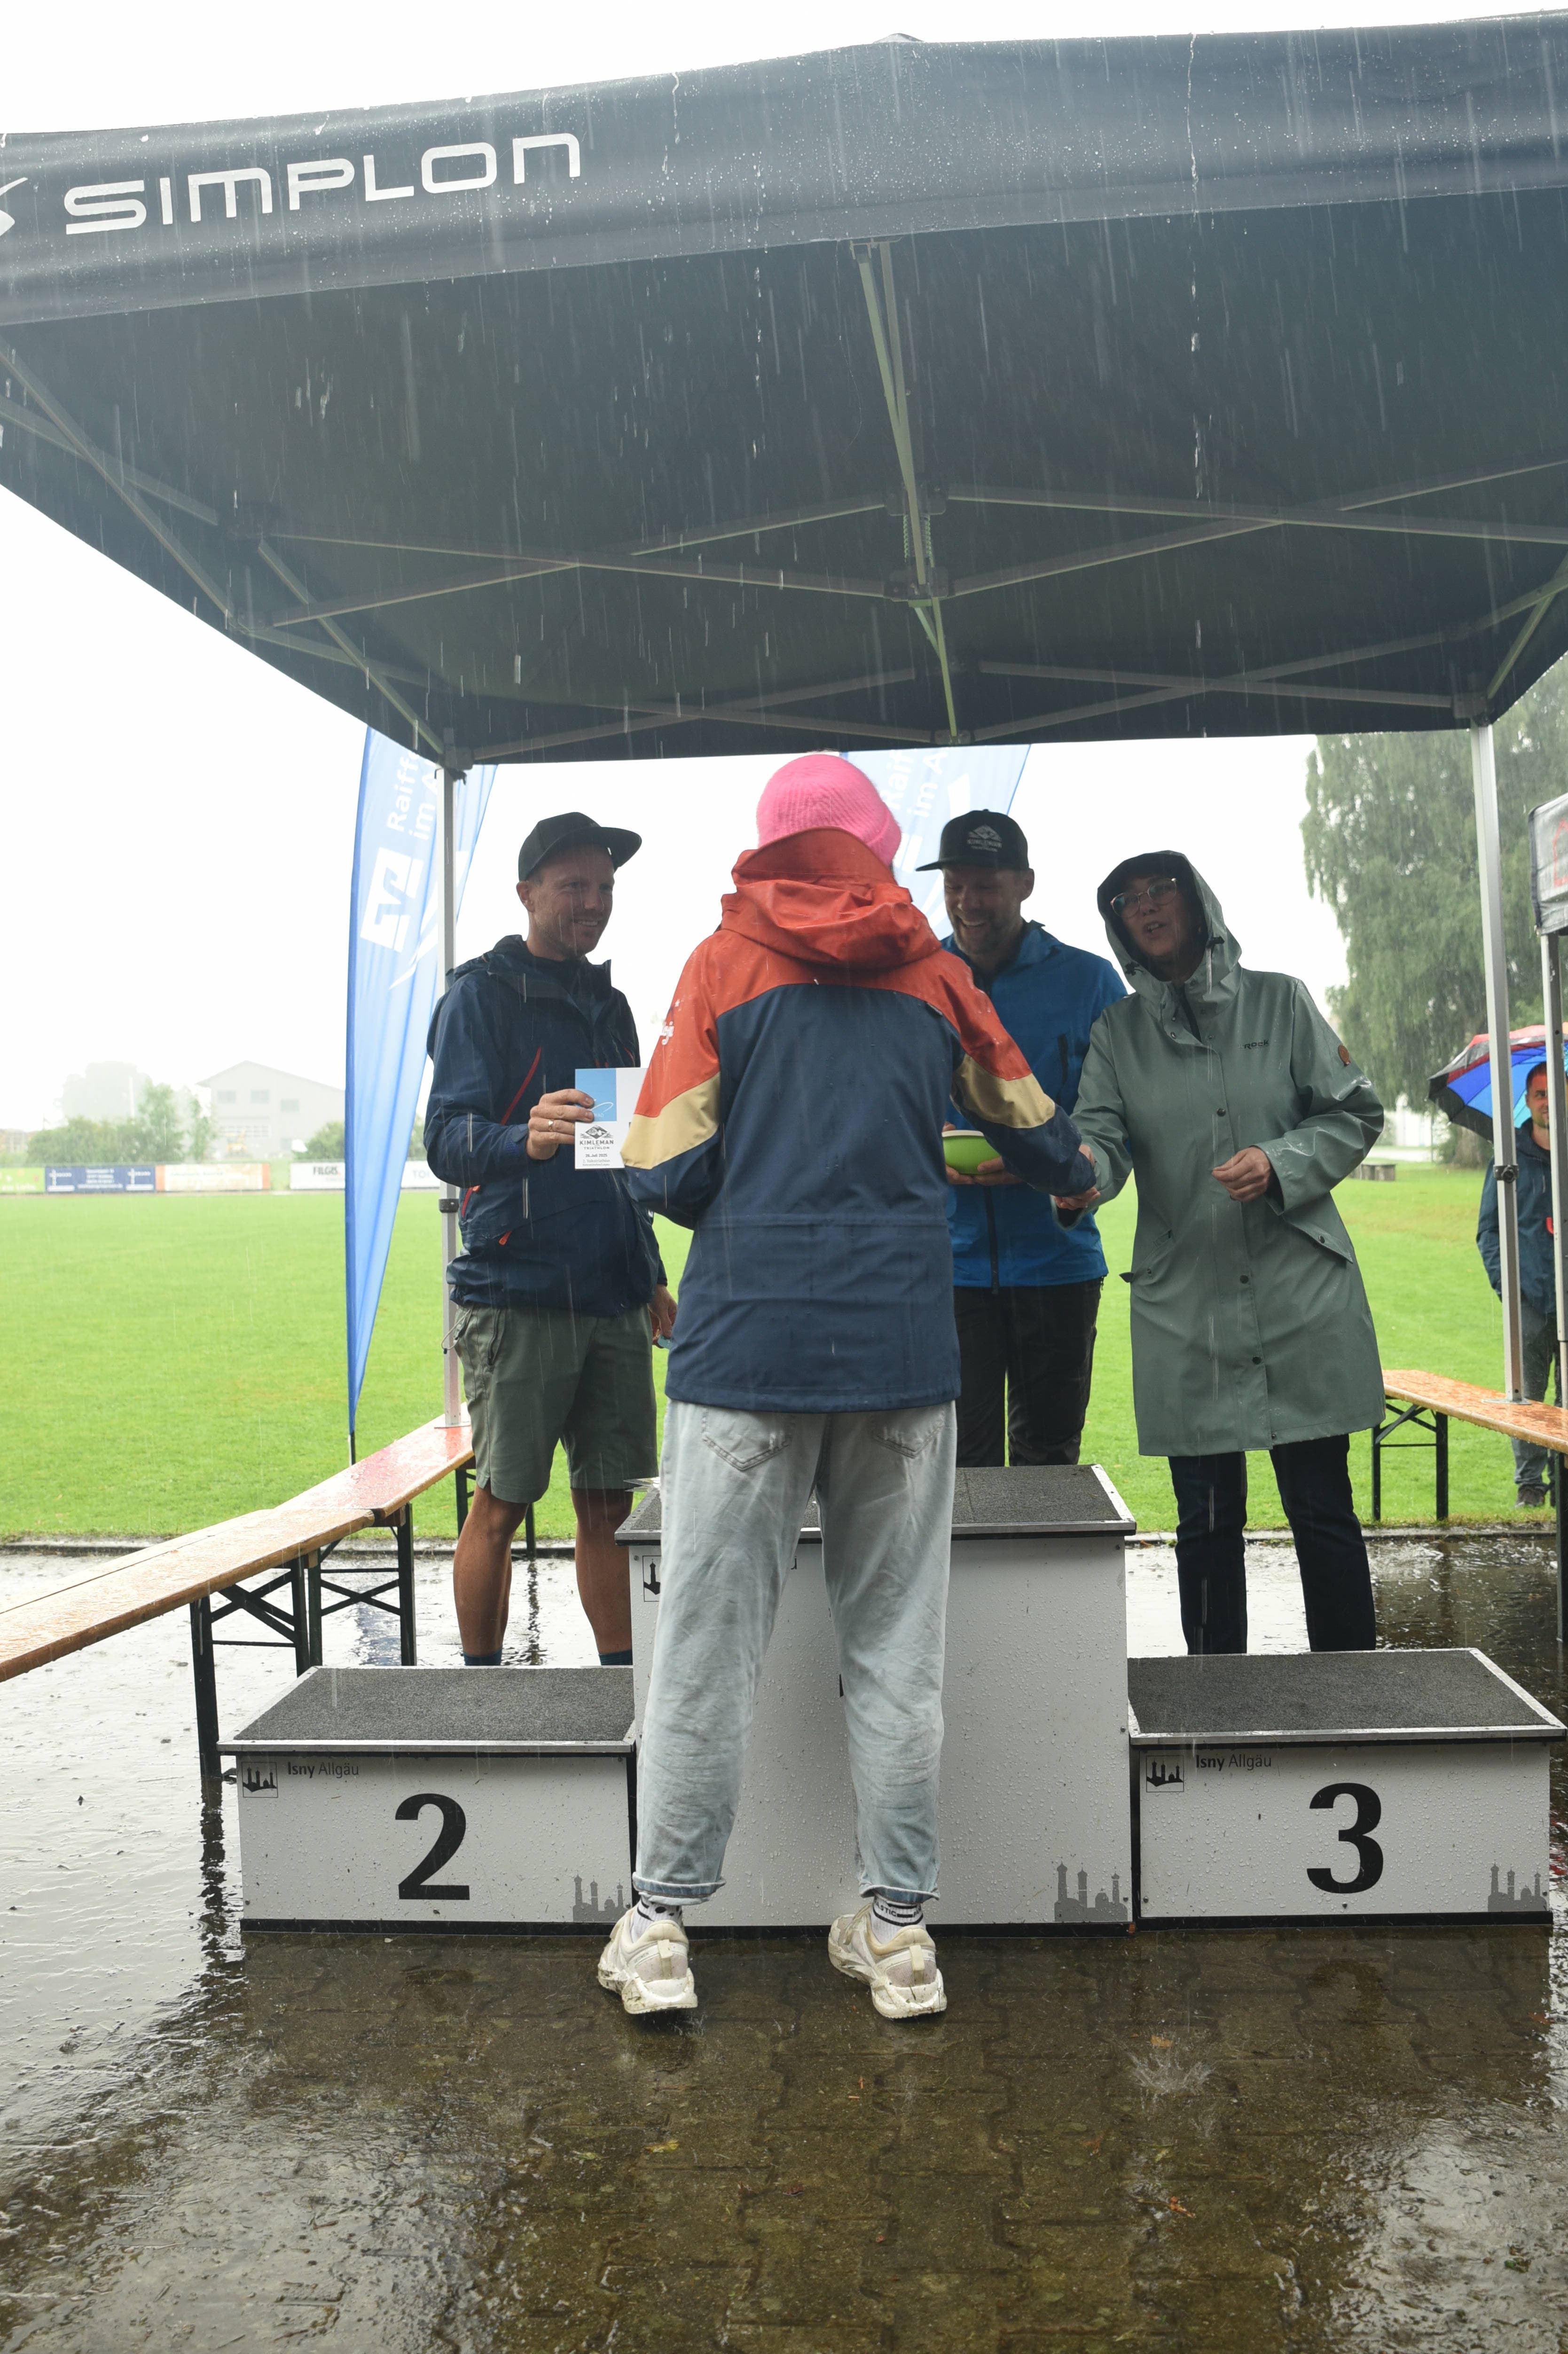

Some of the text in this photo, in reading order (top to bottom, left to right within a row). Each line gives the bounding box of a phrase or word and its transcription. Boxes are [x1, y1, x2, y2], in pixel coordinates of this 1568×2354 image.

[64, 133, 580, 235] SIMPLON
[880, 750, 916, 810] Raif
[907, 783, 938, 818] im
[408, 802, 436, 840] im
[288, 1762, 360, 1779] Isny Allgäu
[1196, 1753, 1272, 1771] Isny Allgäu
[395, 1793, 470, 1900] 2
[1307, 1782, 1384, 1894] 3
